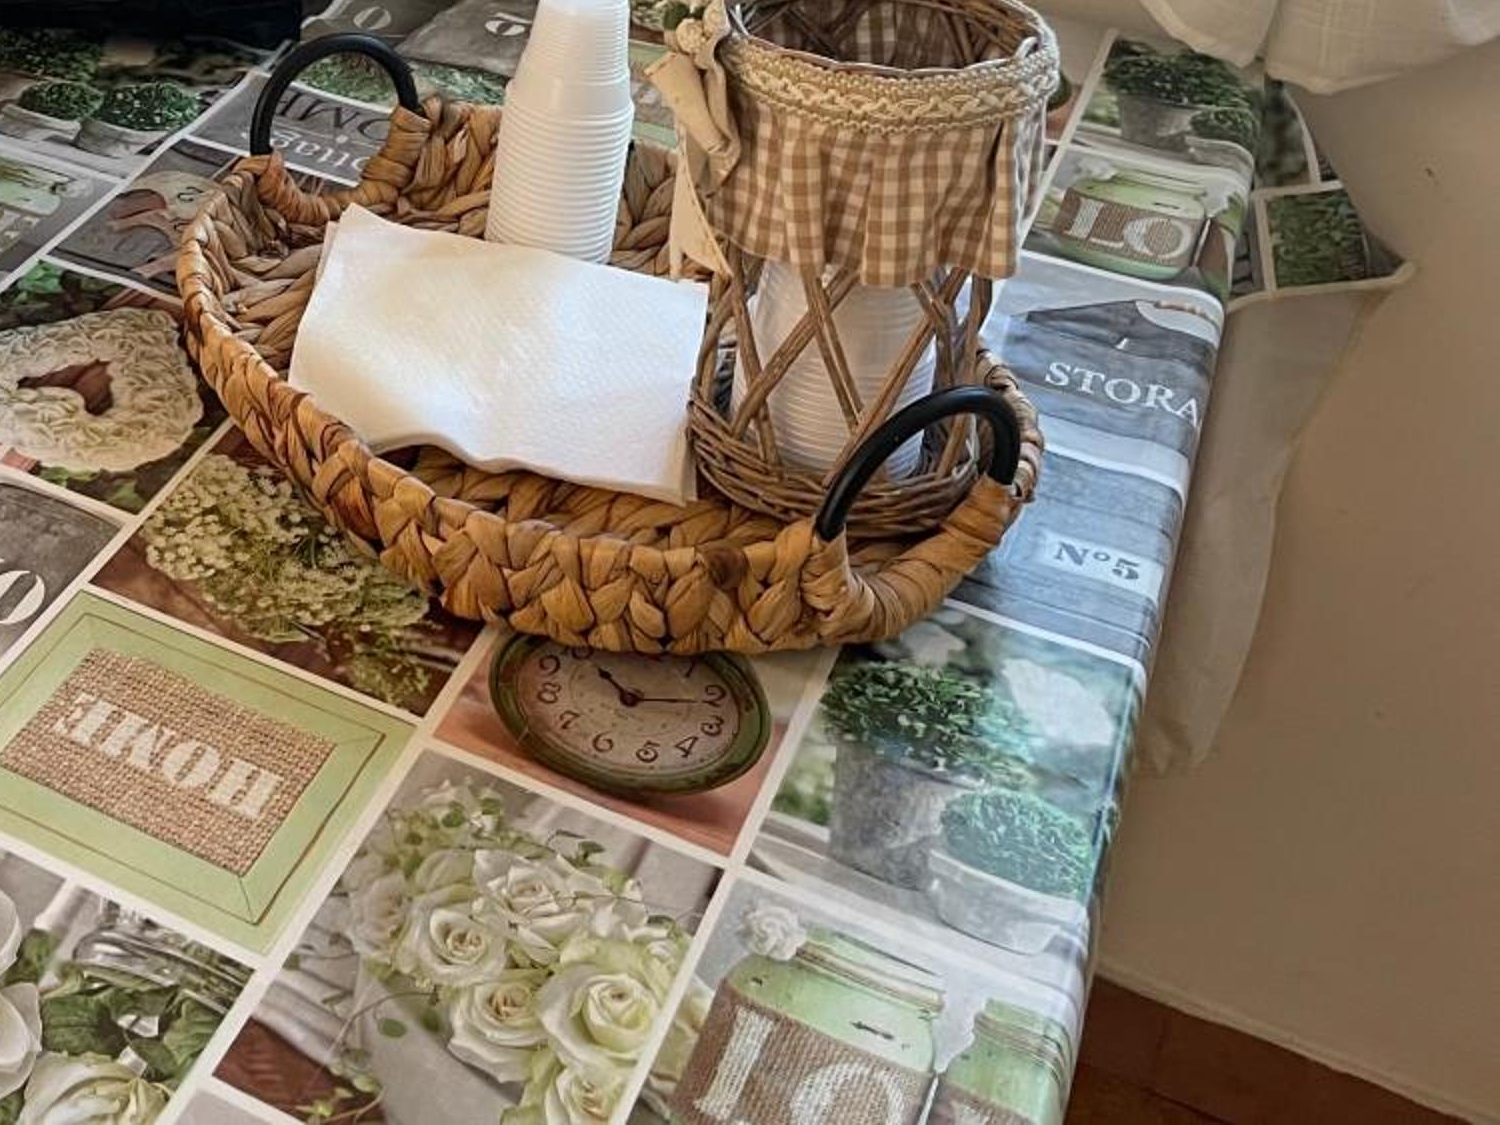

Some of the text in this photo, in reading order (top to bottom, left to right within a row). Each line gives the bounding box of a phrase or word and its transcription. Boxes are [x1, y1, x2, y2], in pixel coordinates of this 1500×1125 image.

[538, 654, 562, 676] 9
[536, 681, 562, 704] 8
[701, 683, 726, 707] 2
[558, 709, 581, 730] 7
[700, 714, 725, 737] 3
[591, 733, 614, 754] 6
[634, 740, 661, 764] 5
[674, 735, 700, 758] 4
[53, 692, 285, 820] HOME
